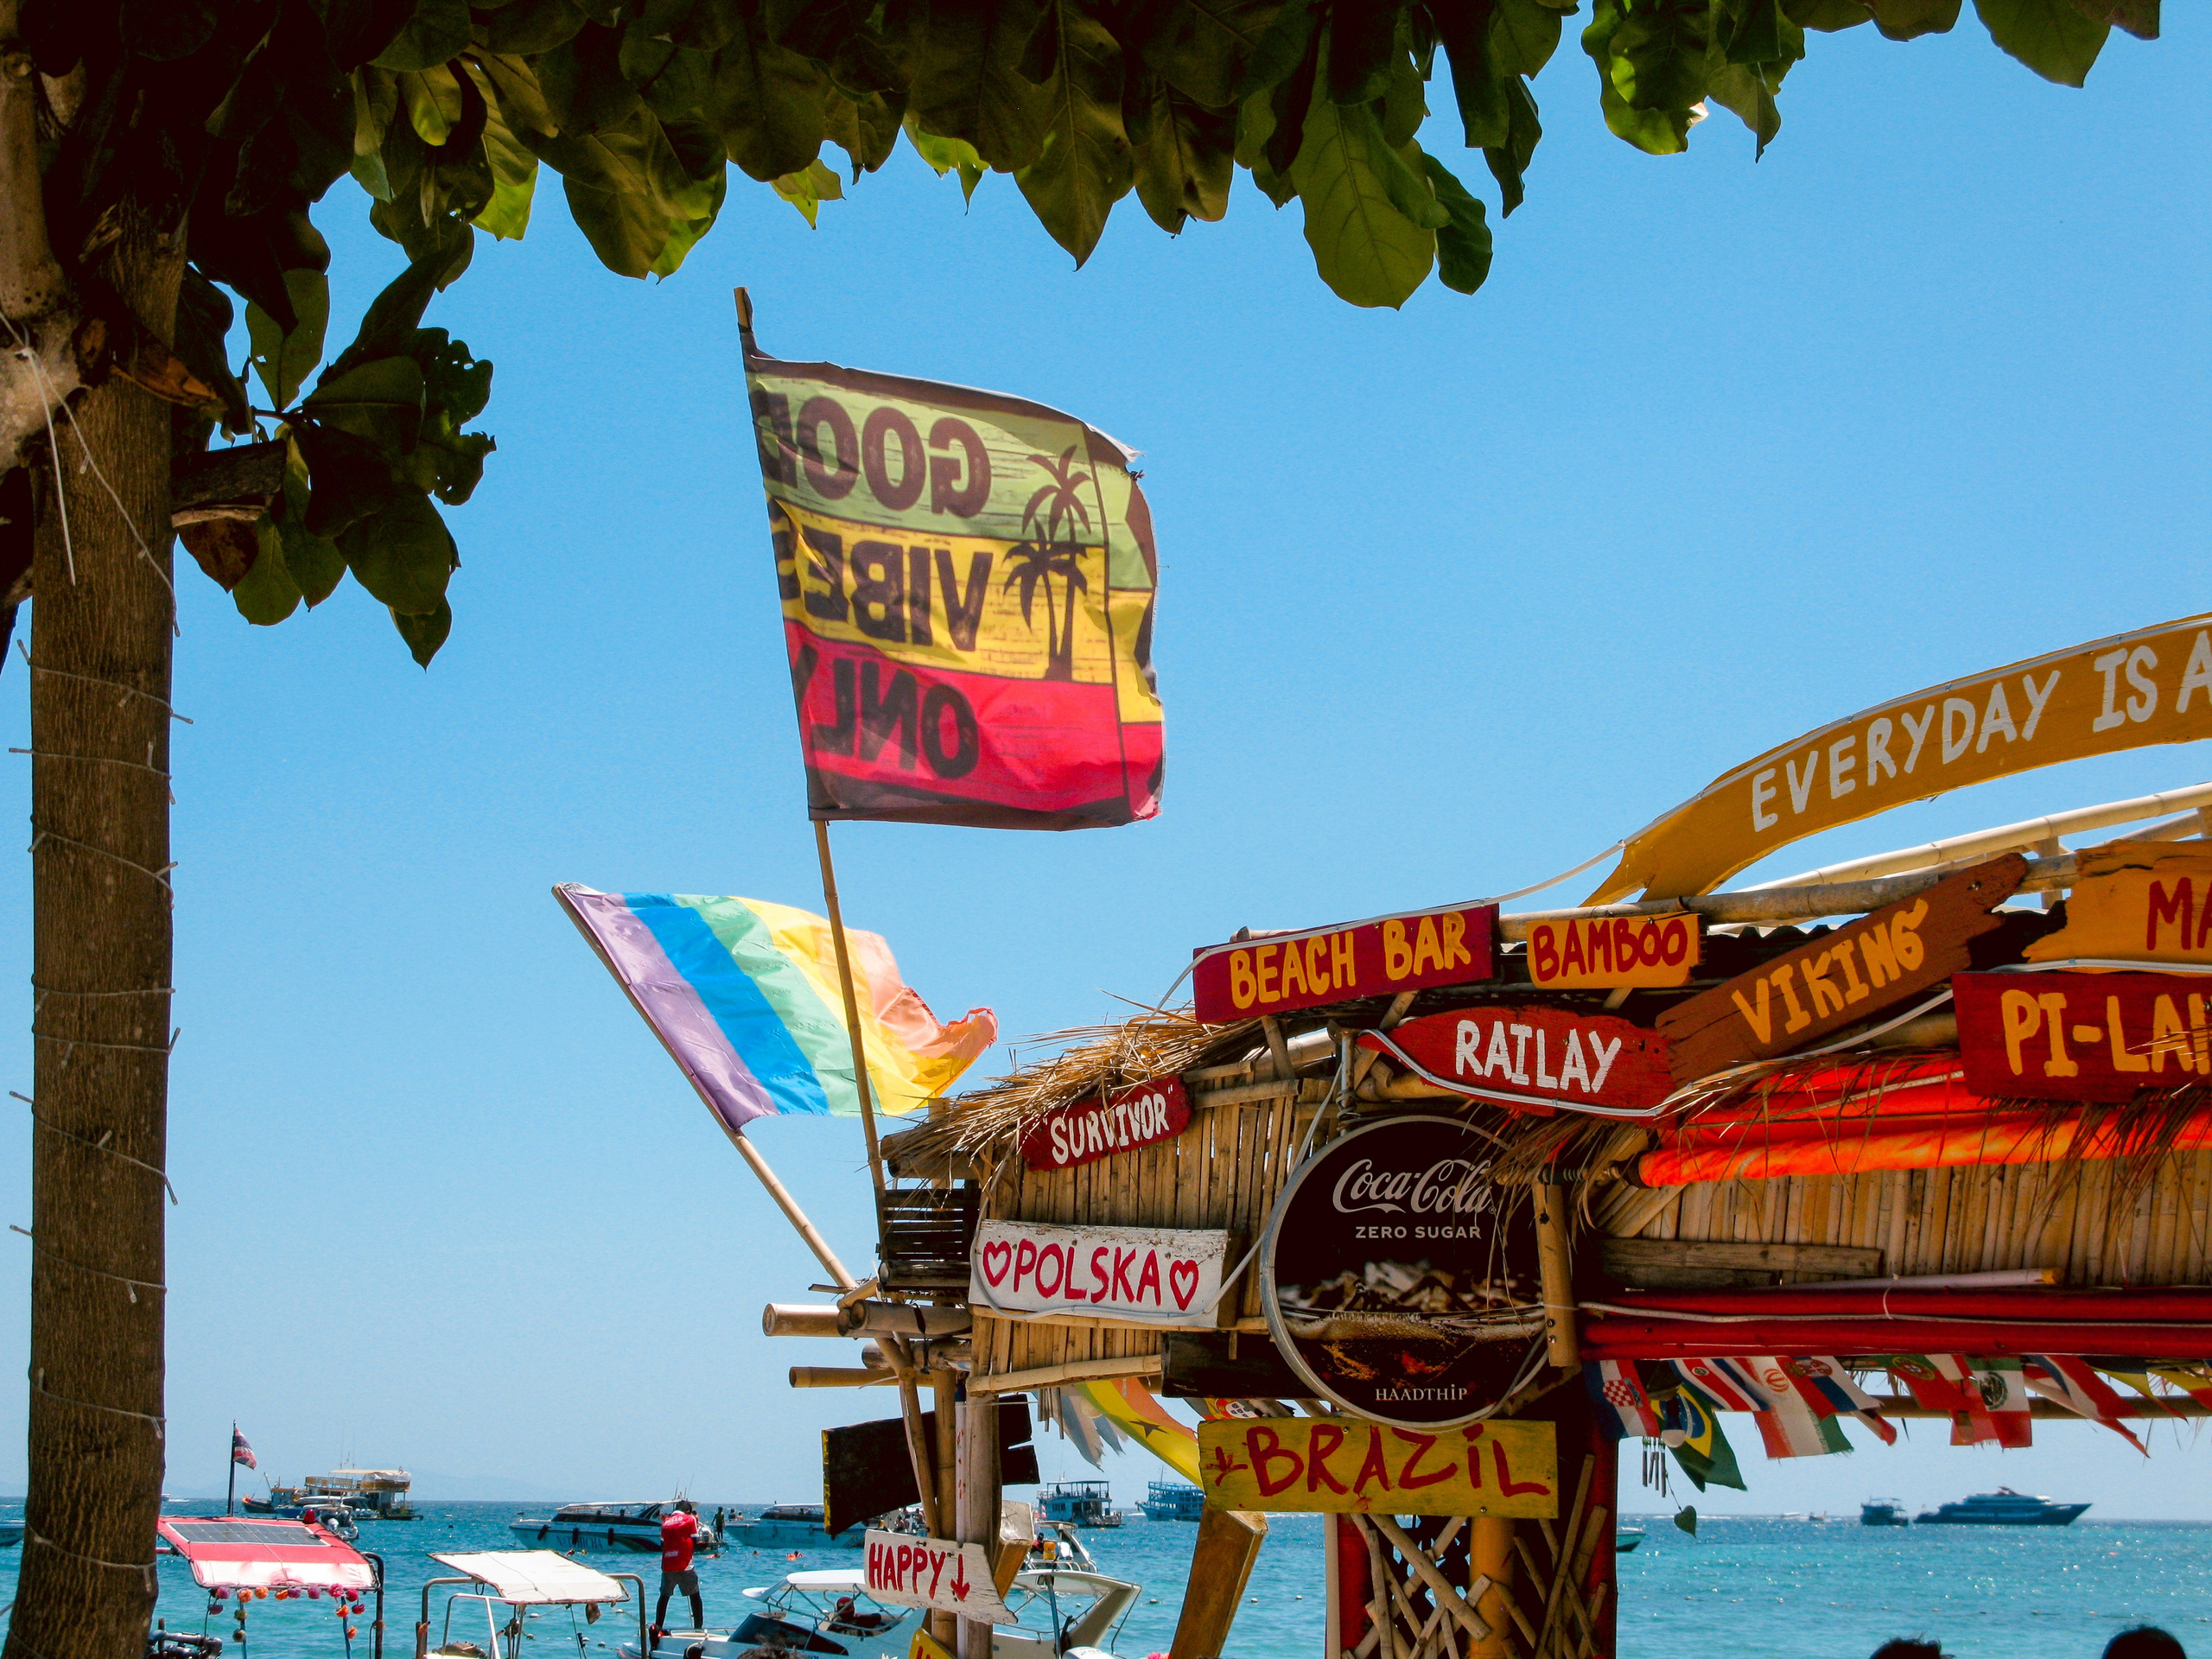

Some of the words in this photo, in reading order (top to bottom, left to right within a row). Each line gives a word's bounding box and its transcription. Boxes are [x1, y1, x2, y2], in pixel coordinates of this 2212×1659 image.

[1751, 669, 2062, 833] EVERYDAY
[2093, 645, 2158, 733] IS
[1230, 930, 1356, 1010] BEACH
[1382, 911, 1471, 982] BAR
[1531, 917, 1689, 982] BAMBOO
[1731, 898, 1929, 1046] VIKING
[1454, 1019, 1623, 1093] RAILAY
[1332, 1158, 1494, 1214] Coca-Cola
[1355, 1225, 1408, 1239] ZERO
[1414, 1225, 1482, 1239] SUGAR
[1013, 1238, 1162, 1306] POLSKA
[868, 1541, 947, 1601] HAPPY
